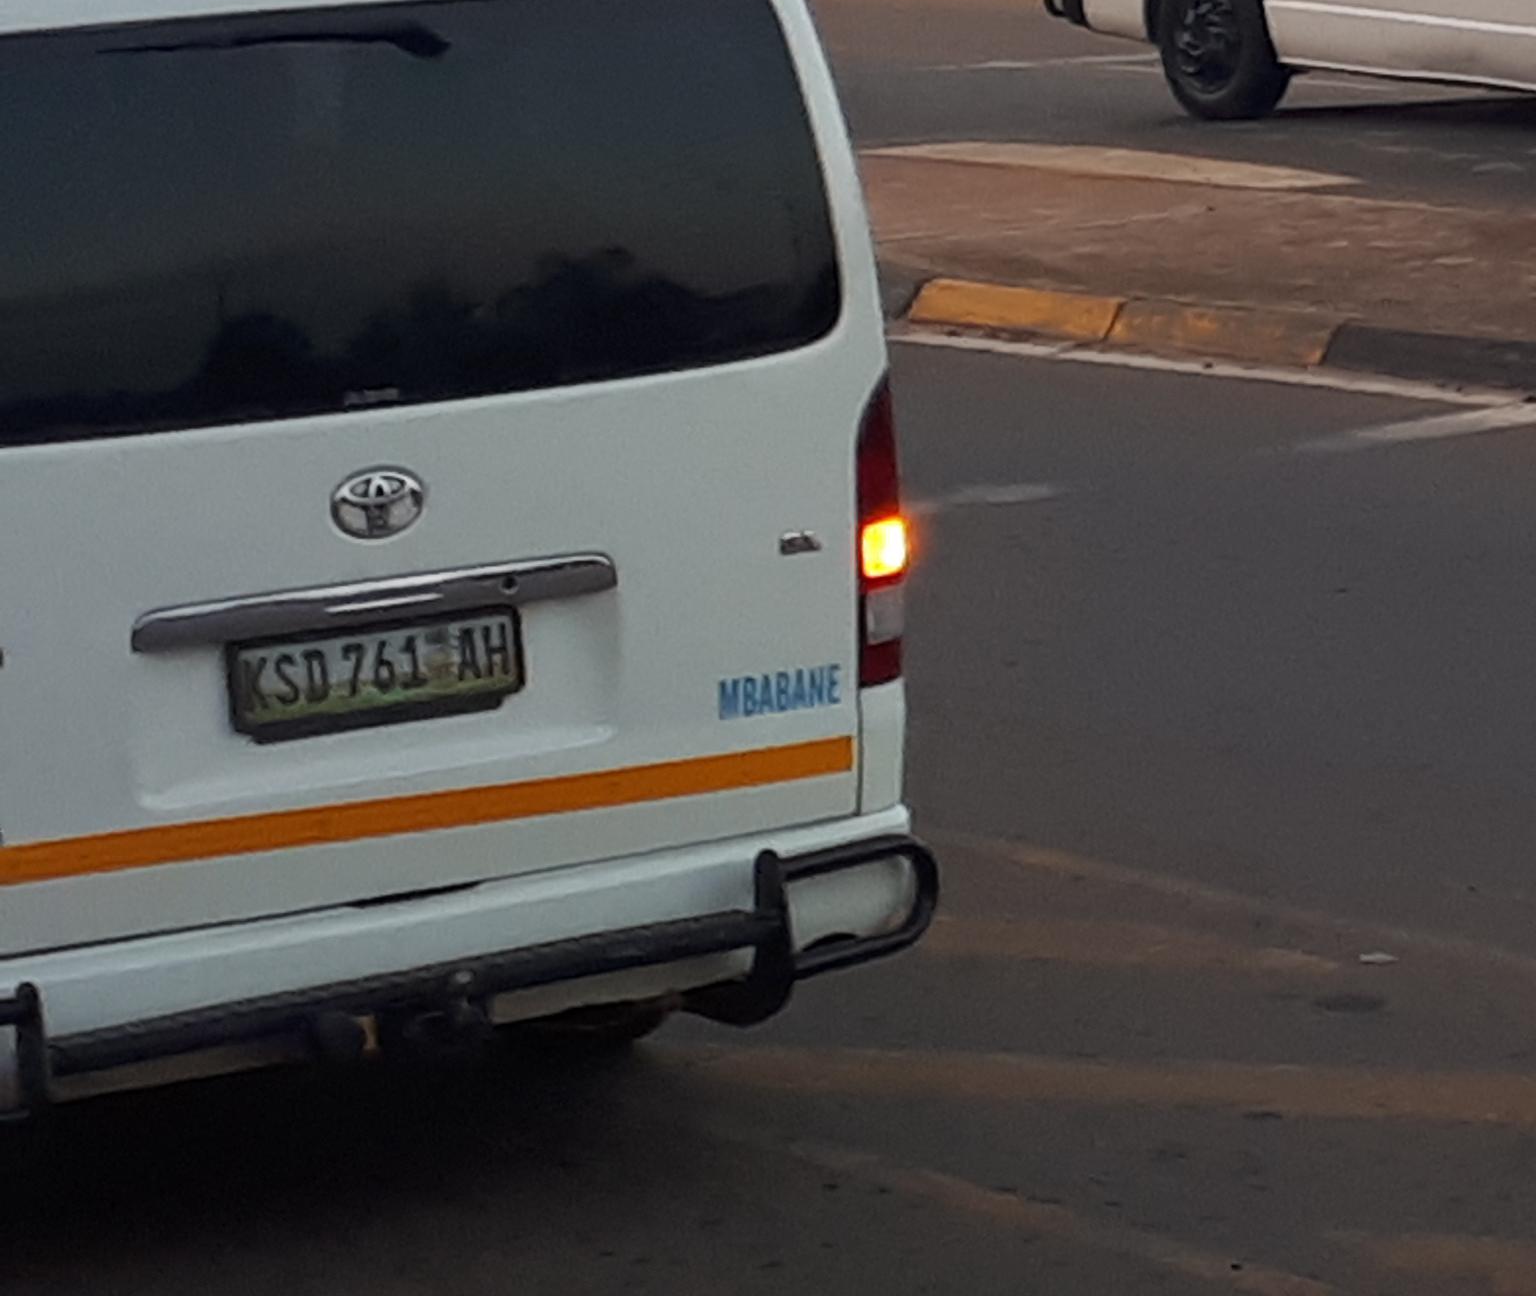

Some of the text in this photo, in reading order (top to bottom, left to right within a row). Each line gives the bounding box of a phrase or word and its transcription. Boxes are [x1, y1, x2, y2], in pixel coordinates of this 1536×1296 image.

[242, 622, 511, 710] KSD 761 AH
[718, 663, 841, 721] MBABANE
